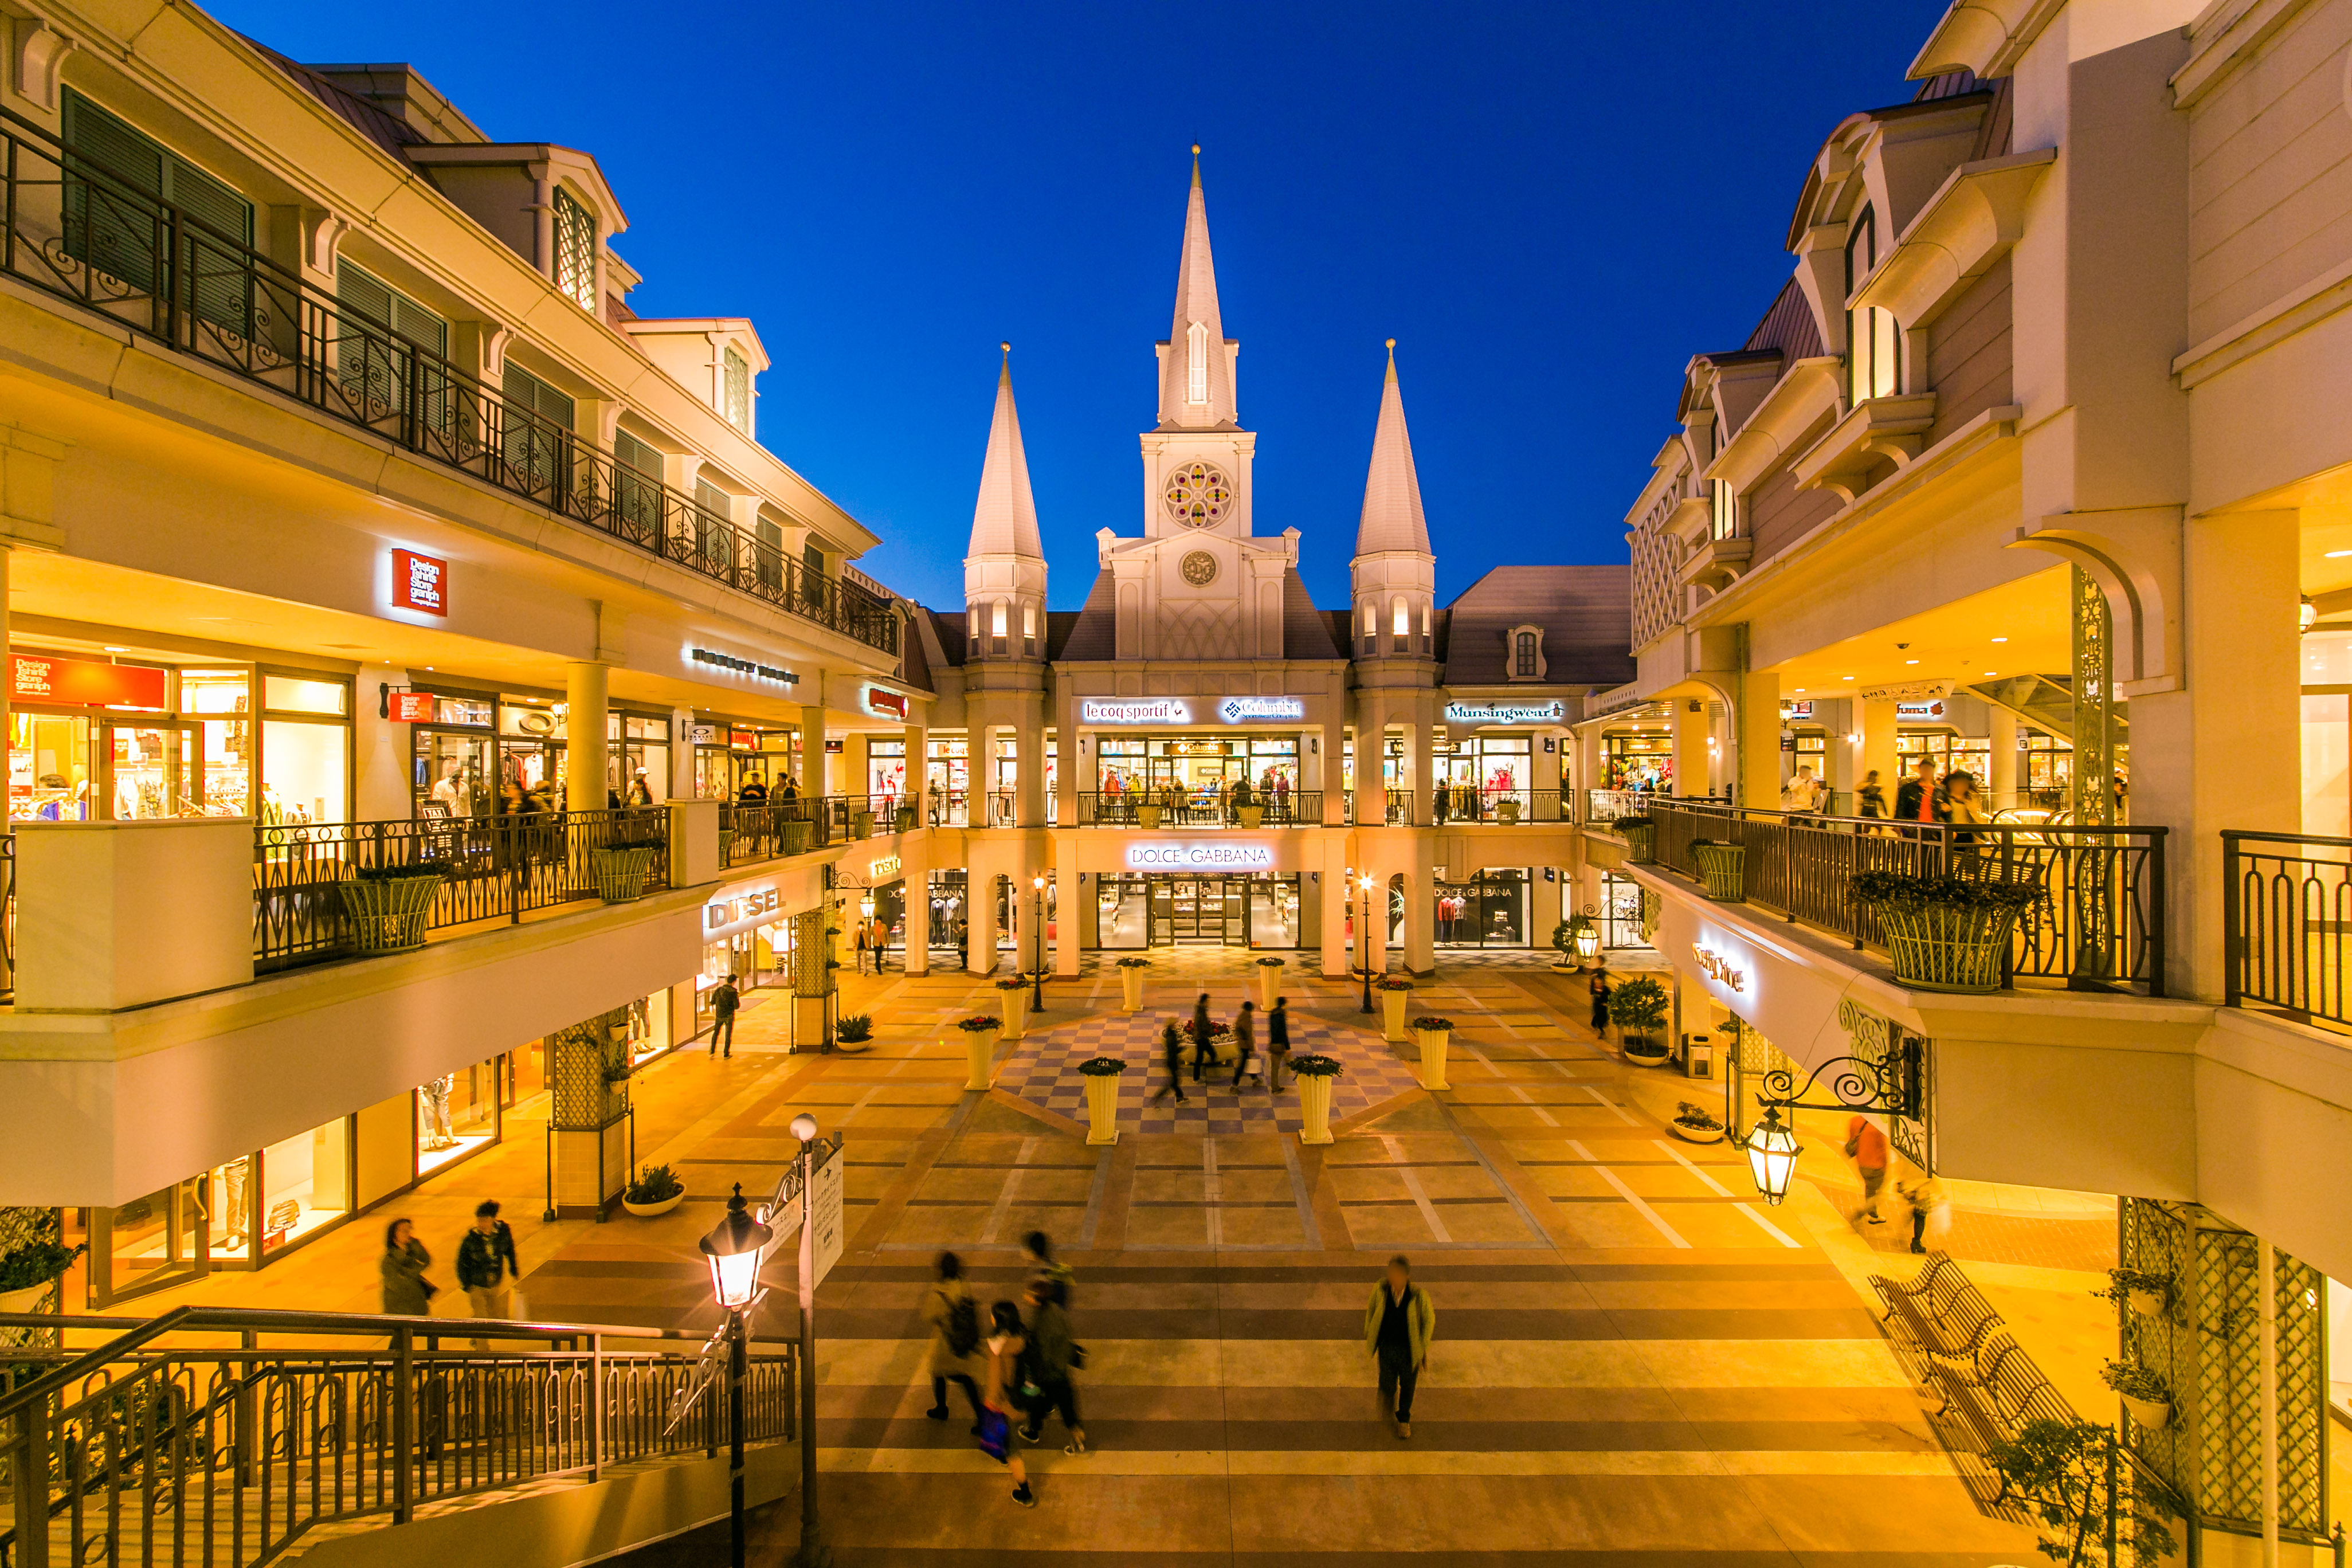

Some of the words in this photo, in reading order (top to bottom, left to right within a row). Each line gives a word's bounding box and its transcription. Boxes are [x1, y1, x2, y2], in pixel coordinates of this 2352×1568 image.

[410, 558, 440, 575] Design
[410, 577, 433, 592] Store
[410, 587, 440, 602] graniph
[16, 658, 50, 669] Design
[15, 673, 42, 683] Store
[15, 681, 50, 692] graniph
[1087, 704, 1098, 717] le
[1101, 708, 1123, 719] coq
[1127, 704, 1168, 719] sportif
[1242, 701, 1299, 712] Columbia
[1896, 704, 1928, 714] fuma
[1450, 707, 1550, 720] Munsingwear
[1133, 849, 1181, 863] DOLCE
[1191, 849, 1268, 863] GABBANA
[928, 889, 964, 898] ABBANA
[1434, 888, 1462, 897] DOLCE
[1467, 888, 1512, 897] GABBANA
[709, 888, 787, 928] DIESEL
